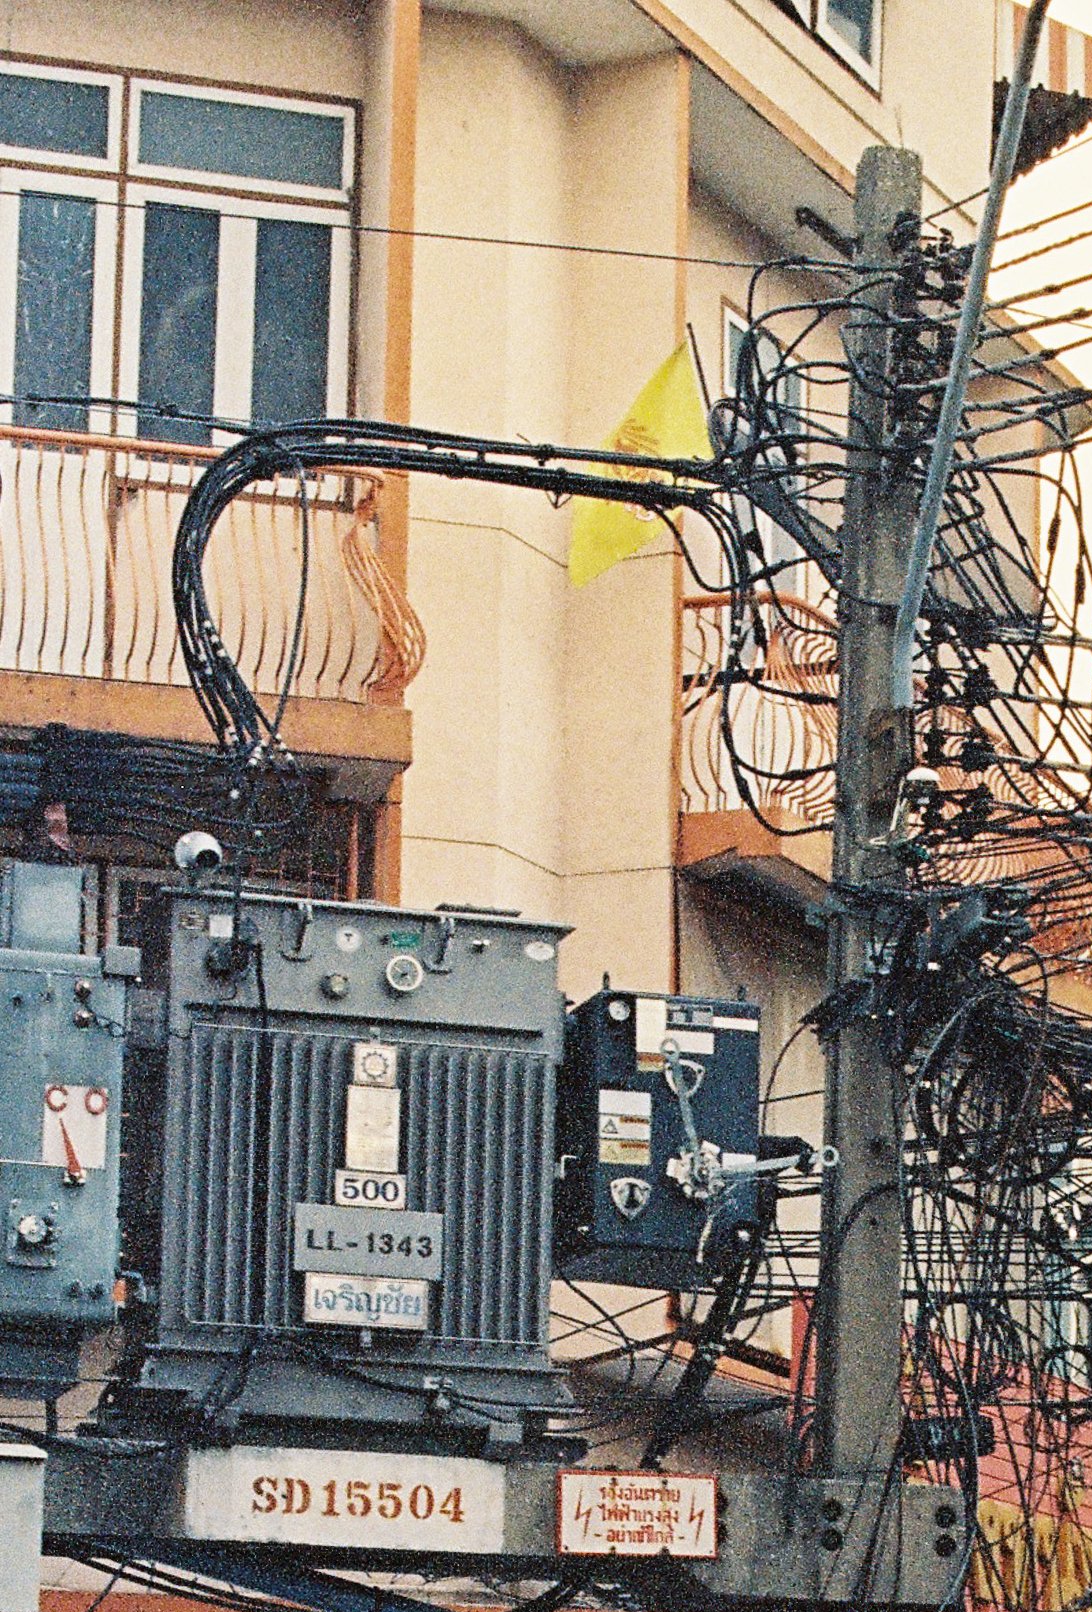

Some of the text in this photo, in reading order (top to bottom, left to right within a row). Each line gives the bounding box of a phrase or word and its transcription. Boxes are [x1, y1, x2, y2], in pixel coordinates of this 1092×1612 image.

[45, 1085, 109, 1115] C O
[342, 1178, 399, 1202] 500
[306, 1228, 433, 1258] LL-1343
[312, 1284, 420, 1321] เจริญชัย
[252, 1475, 465, 1523] SD15504
[597, 1502, 679, 1523] ไฟฟ้าแรงสูง
